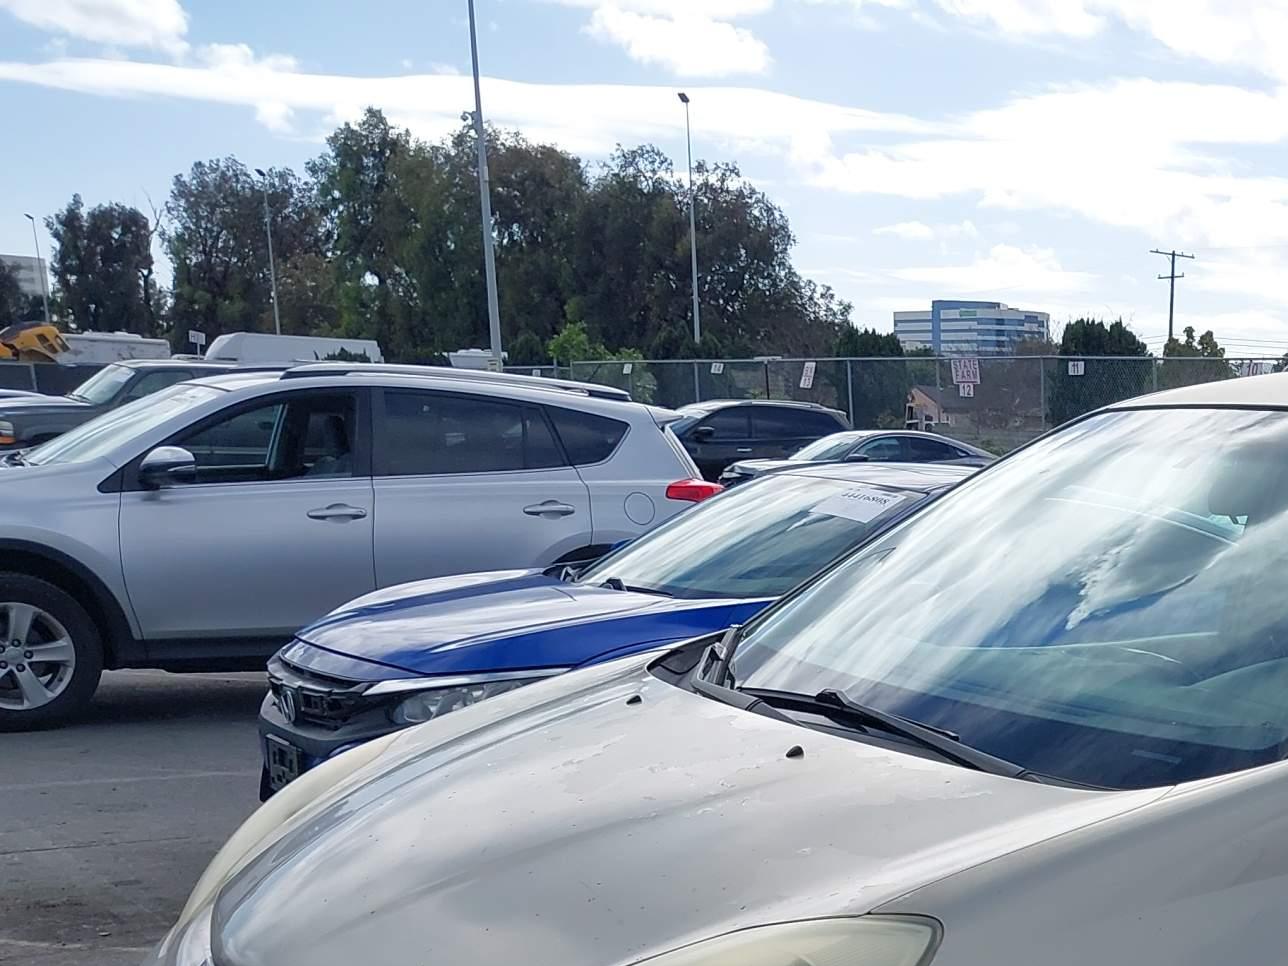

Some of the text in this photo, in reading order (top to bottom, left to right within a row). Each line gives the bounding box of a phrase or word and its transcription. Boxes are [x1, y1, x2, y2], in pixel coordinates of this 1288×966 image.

[953, 359, 978, 370] STATE
[1071, 363, 1080, 375] 11
[955, 370, 978, 380] FARM
[962, 384, 972, 396] 12
